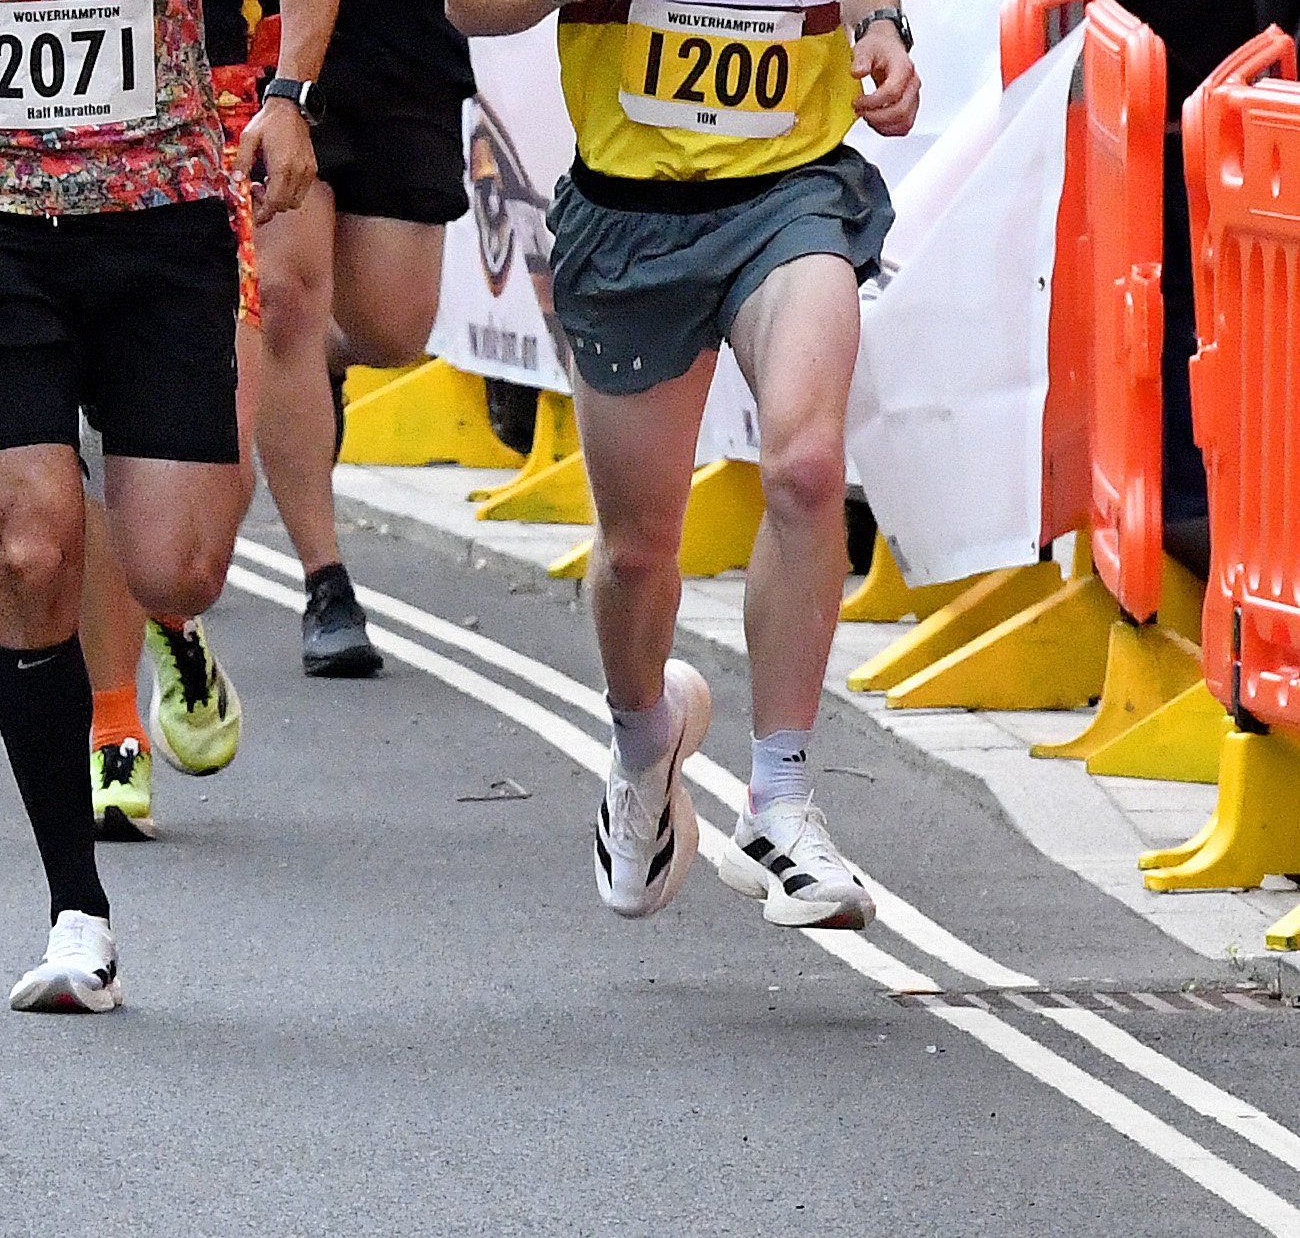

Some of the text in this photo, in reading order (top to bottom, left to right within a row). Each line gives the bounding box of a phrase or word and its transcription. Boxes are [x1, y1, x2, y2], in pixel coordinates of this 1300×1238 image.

[13, 6, 121, 23] WOLVERHAMPTON
[667, 12, 775, 34] WOLVERHAMPTON
[643, 32, 789, 109] 1200
[27, 103, 112, 120] Half Marathon
[696, 112, 718, 126] 10K
